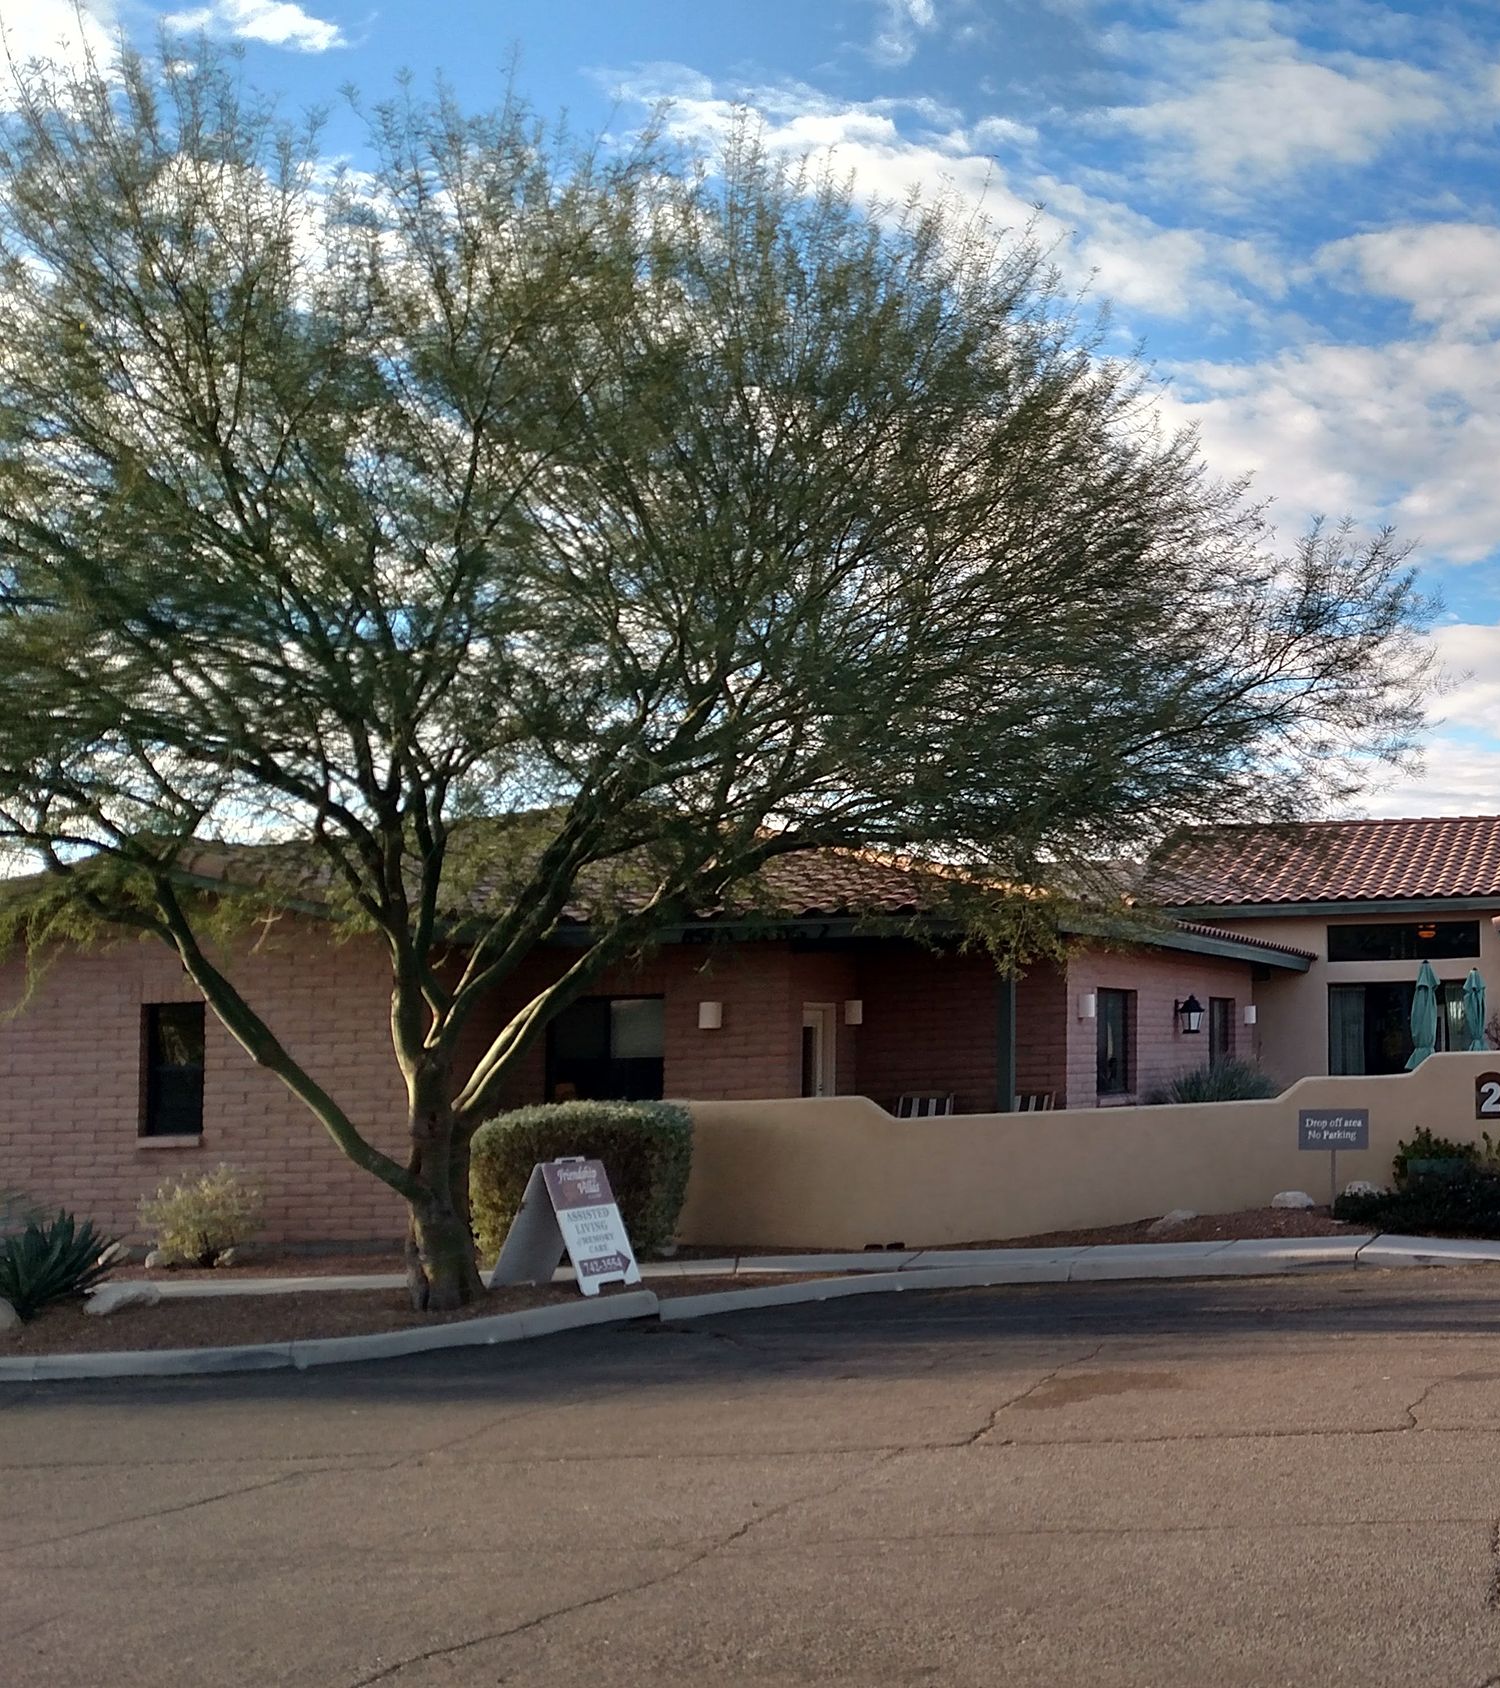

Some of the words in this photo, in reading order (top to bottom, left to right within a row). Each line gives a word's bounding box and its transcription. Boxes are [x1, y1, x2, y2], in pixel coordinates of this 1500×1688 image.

[1305, 1118, 1328, 1130] Drop
[1329, 1117, 1343, 1128] off
[1344, 1119, 1362, 1128] area
[1308, 1130, 1321, 1140] No
[1323, 1130, 1357, 1142] Parking
[567, 1207, 609, 1221] ASSISTED
[575, 1220, 608, 1234] LIVING
[589, 1244, 608, 1253] CARE
